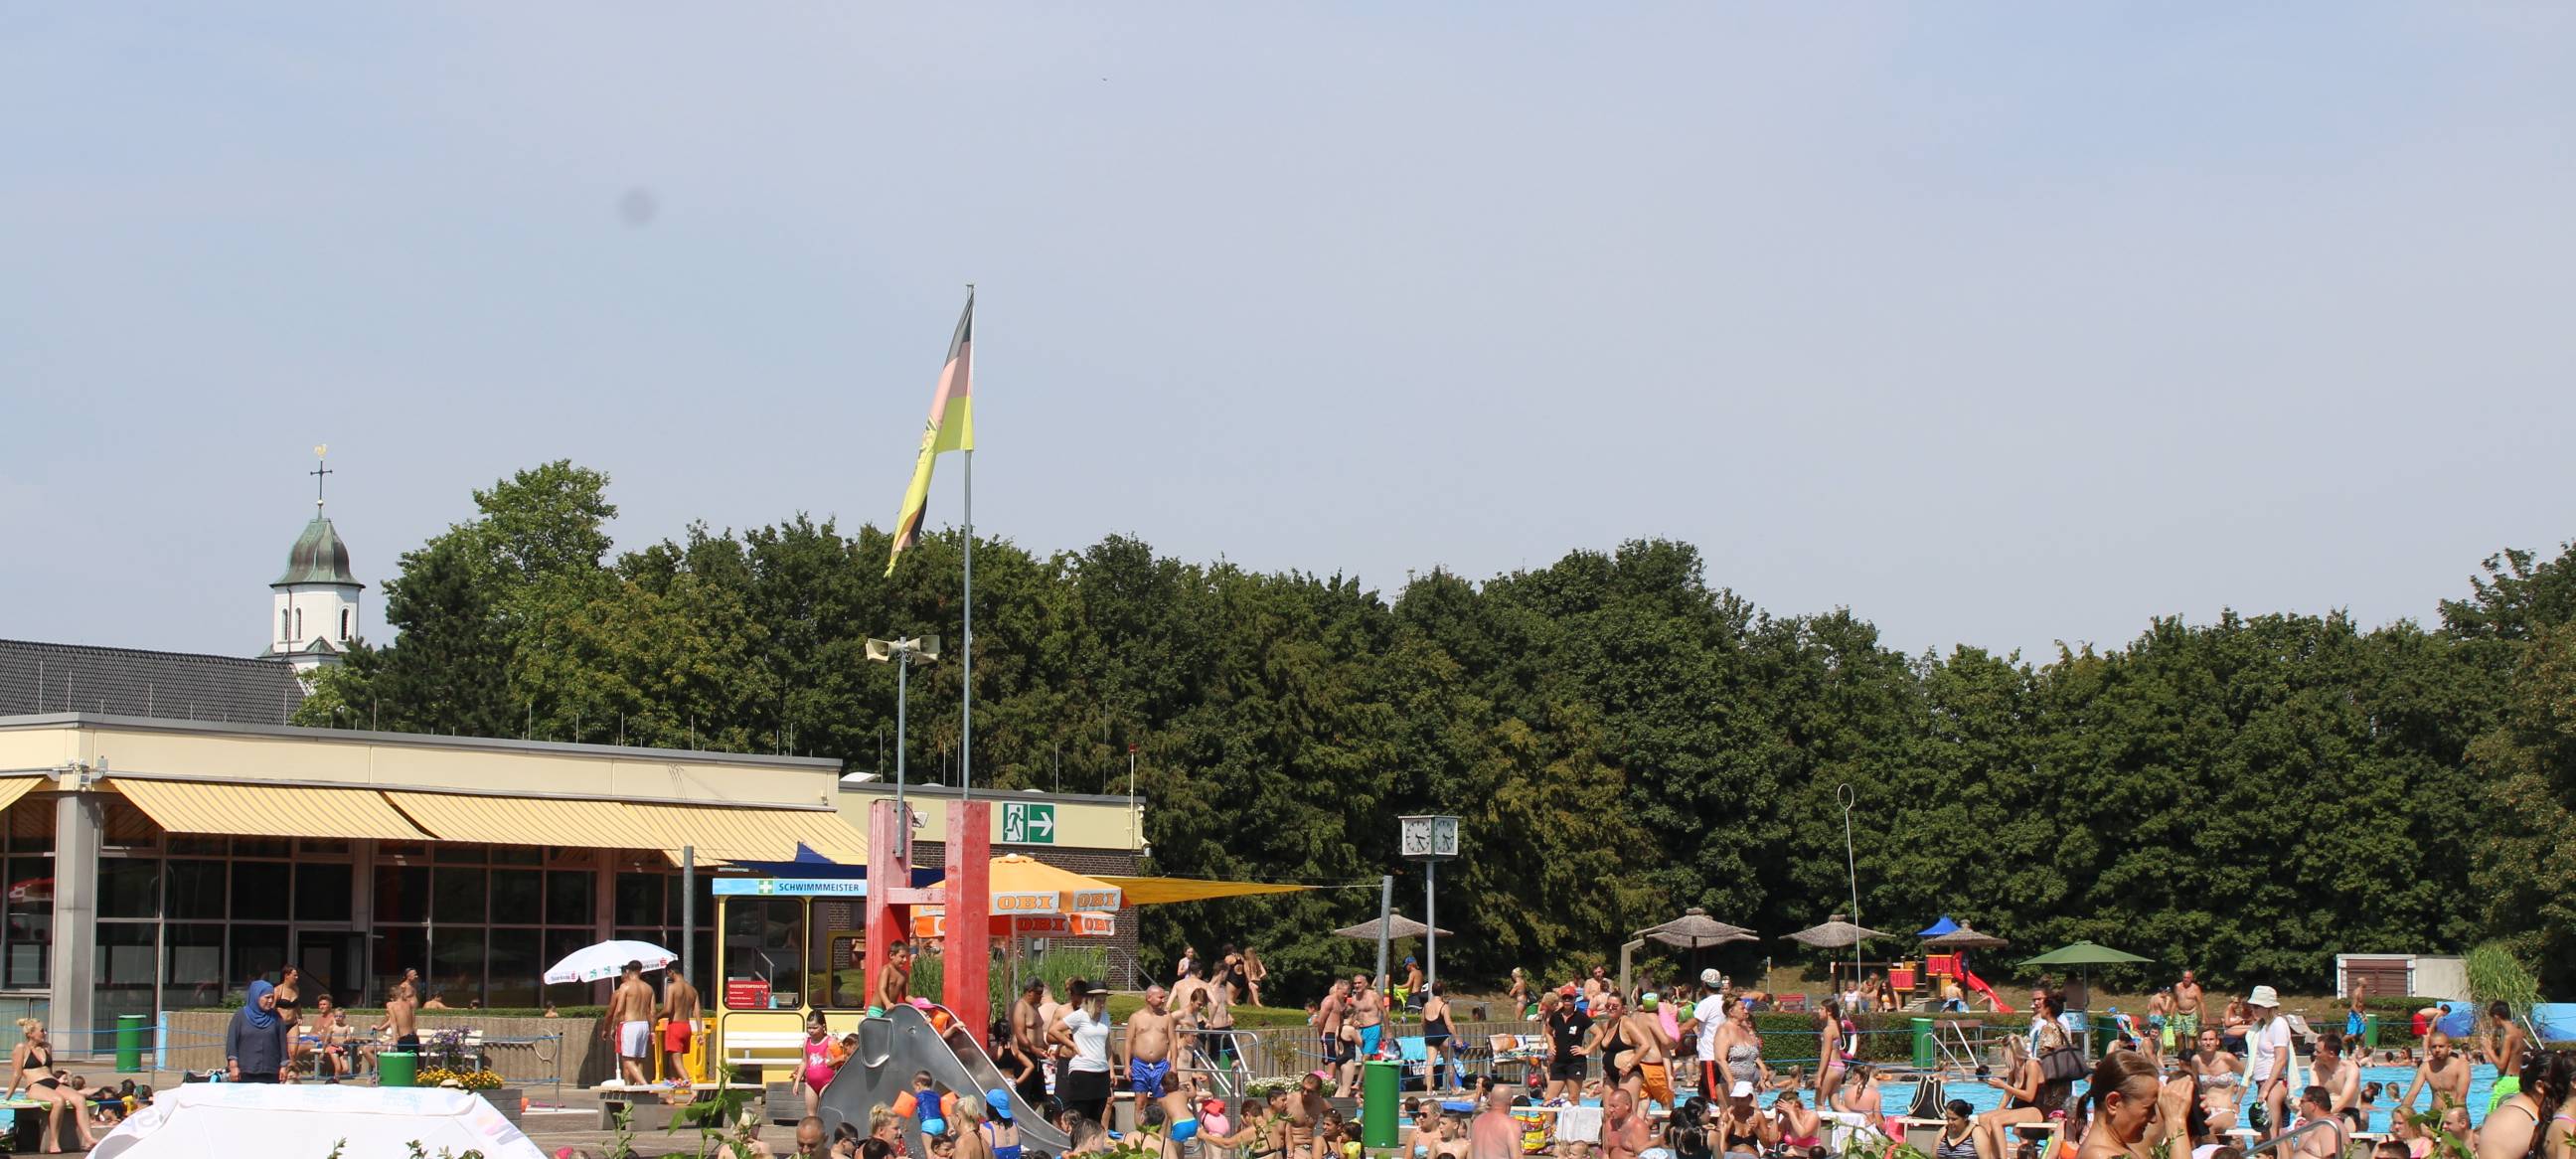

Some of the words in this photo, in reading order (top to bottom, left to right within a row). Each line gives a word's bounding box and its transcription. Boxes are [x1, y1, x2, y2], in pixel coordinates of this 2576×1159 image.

[778, 883, 860, 892] SCHWIMMMEISTER
[997, 896, 1052, 910] OBI
[1077, 893, 1115, 907] OBI
[1017, 917, 1065, 931] OBI
[1084, 916, 1110, 931] OBI
